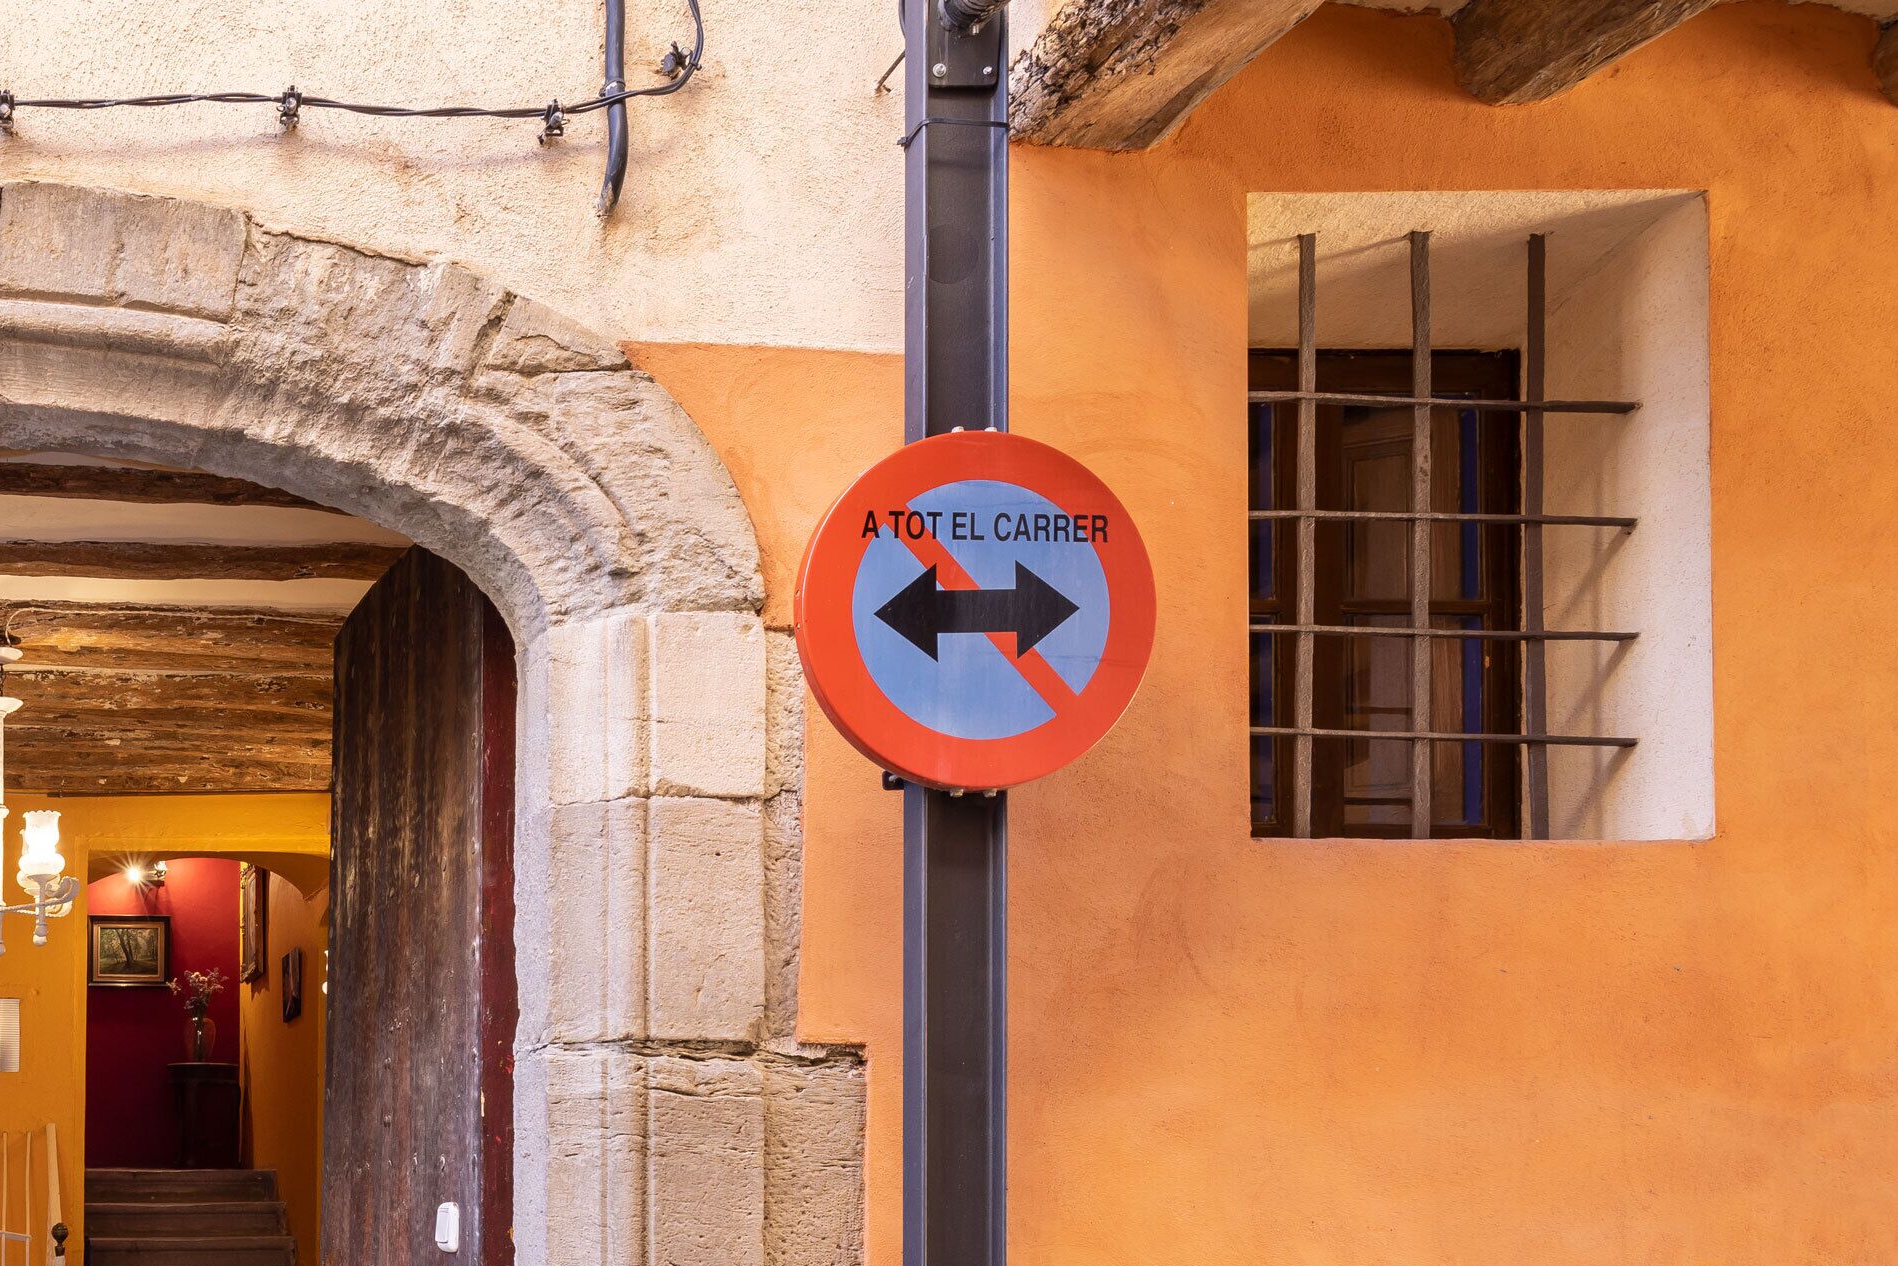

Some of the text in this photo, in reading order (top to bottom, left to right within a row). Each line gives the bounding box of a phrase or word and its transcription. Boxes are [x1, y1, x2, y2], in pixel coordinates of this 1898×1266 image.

[861, 510, 1108, 543] A TOT EL CARRER
